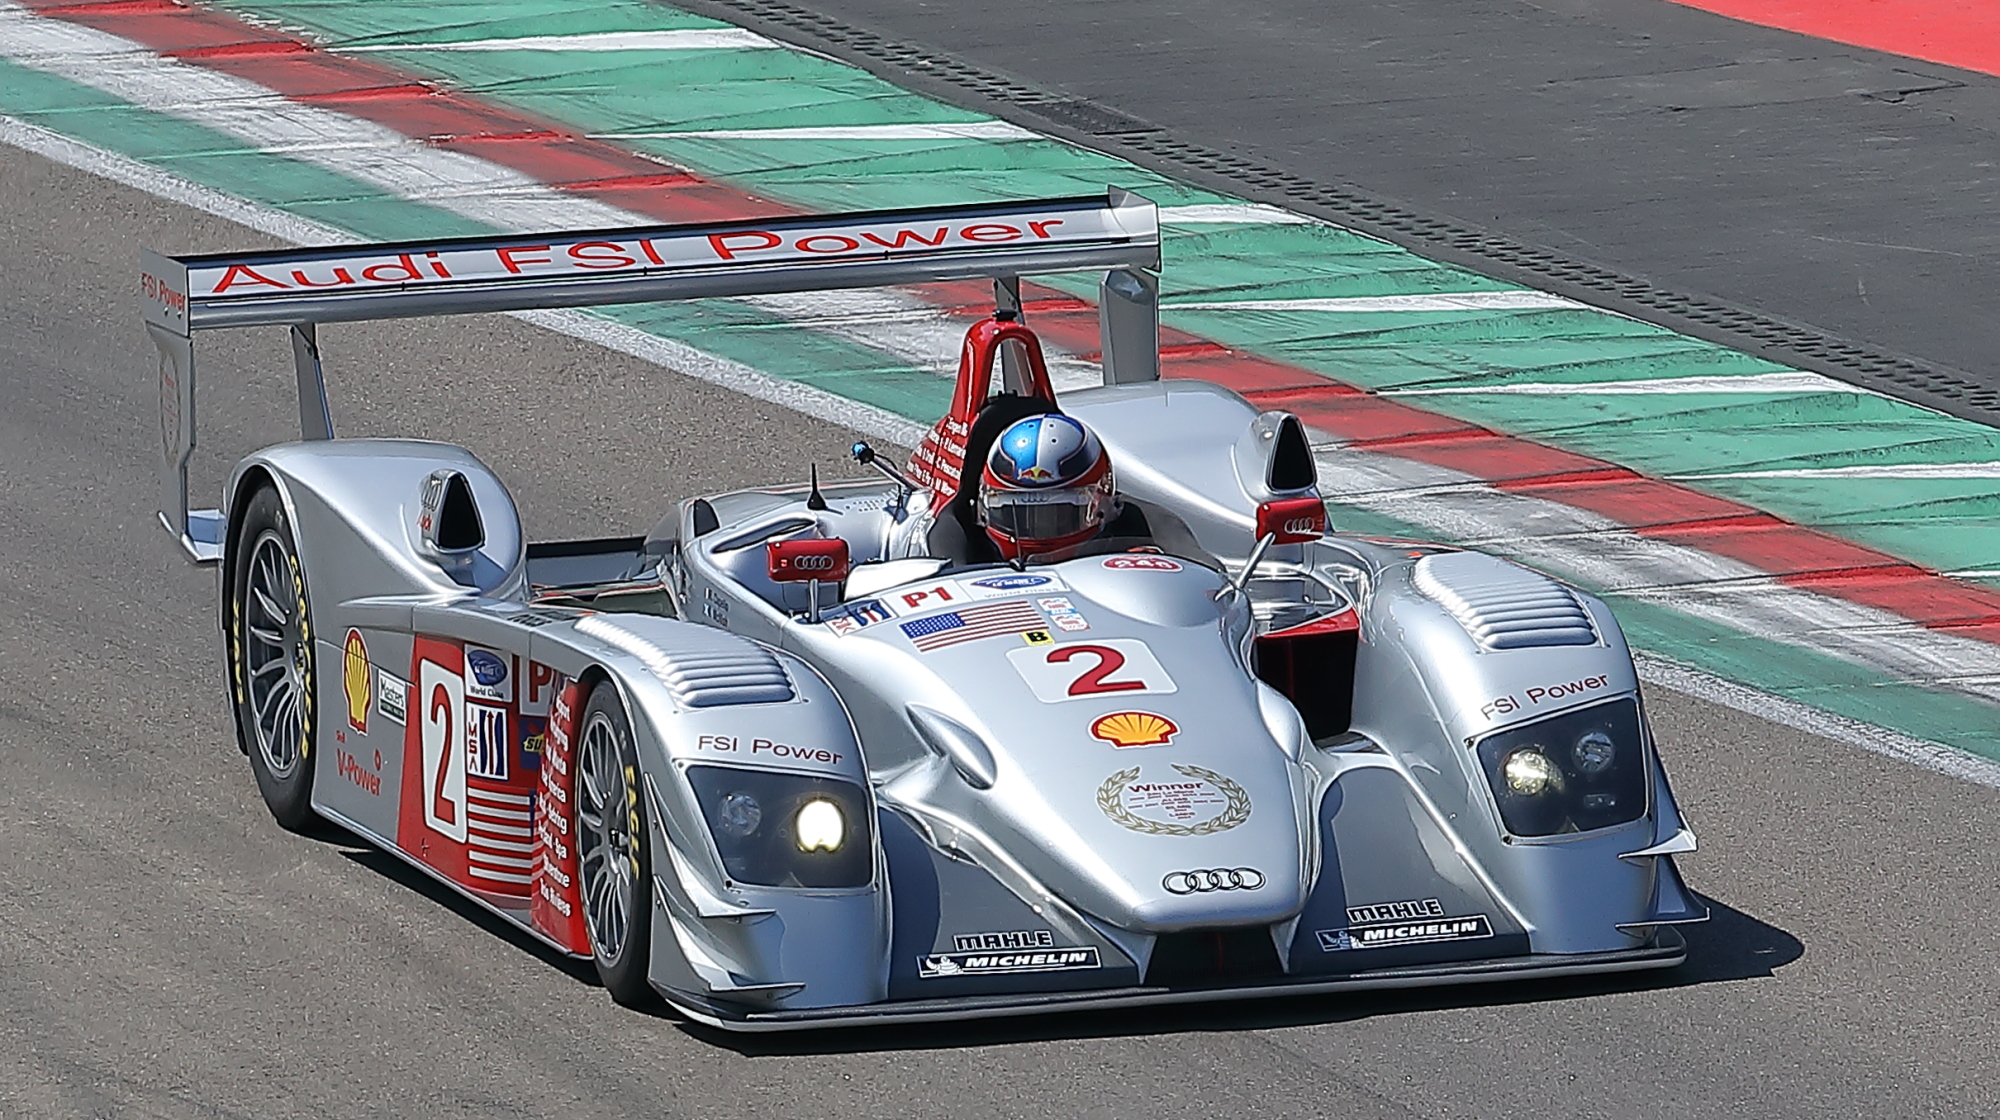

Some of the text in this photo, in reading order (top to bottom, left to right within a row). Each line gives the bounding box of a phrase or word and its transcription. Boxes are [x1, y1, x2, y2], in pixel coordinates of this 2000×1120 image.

[212, 219, 1066, 293] Audi FSI Power
[142, 272, 186, 312] FSI Power
[901, 586, 954, 608] P1
[1026, 631, 1049, 642] B
[1046, 645, 1148, 697] 2
[470, 685, 486, 696] World
[1480, 674, 1609, 721] FSI Power
[430, 683, 457, 826] 2
[468, 707, 478, 772] IMSA
[698, 735, 843, 765] FSI Power
[336, 747, 381, 796] V-Power
[1347, 899, 1445, 923] MAHLE
[954, 931, 1053, 951] MAHLE
[1364, 921, 1477, 941] MICHELIN
[965, 952, 1087, 968] MICHELIN
